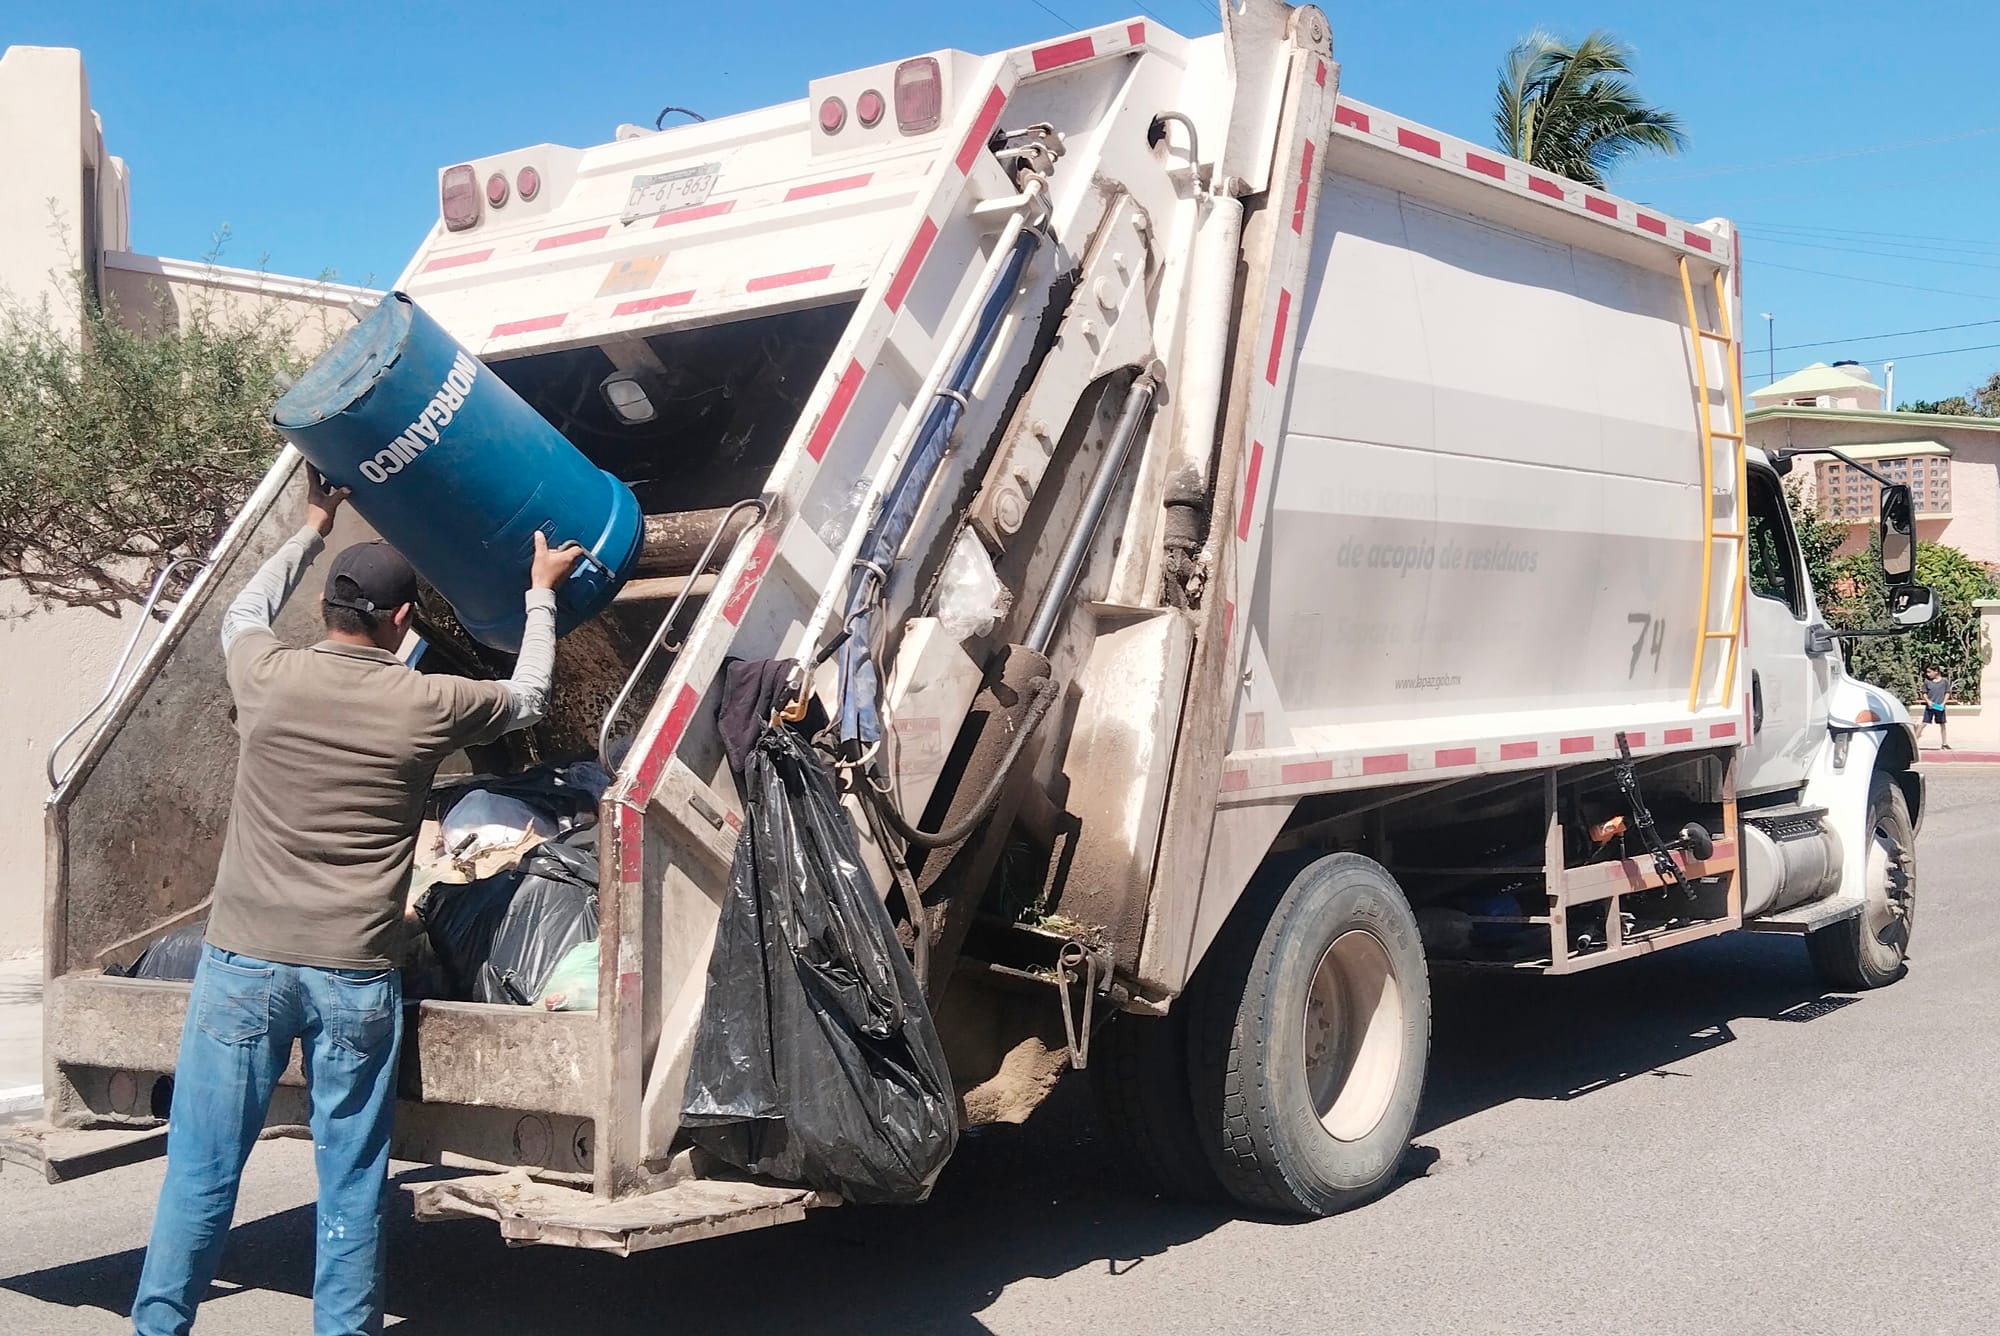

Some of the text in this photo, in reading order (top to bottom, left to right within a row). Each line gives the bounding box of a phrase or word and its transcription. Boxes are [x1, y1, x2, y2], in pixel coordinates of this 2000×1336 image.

[628, 175, 712, 206] CF-61-863
[1336, 534, 1539, 578] de acopio de residuos
[1627, 612, 1666, 681] 74
